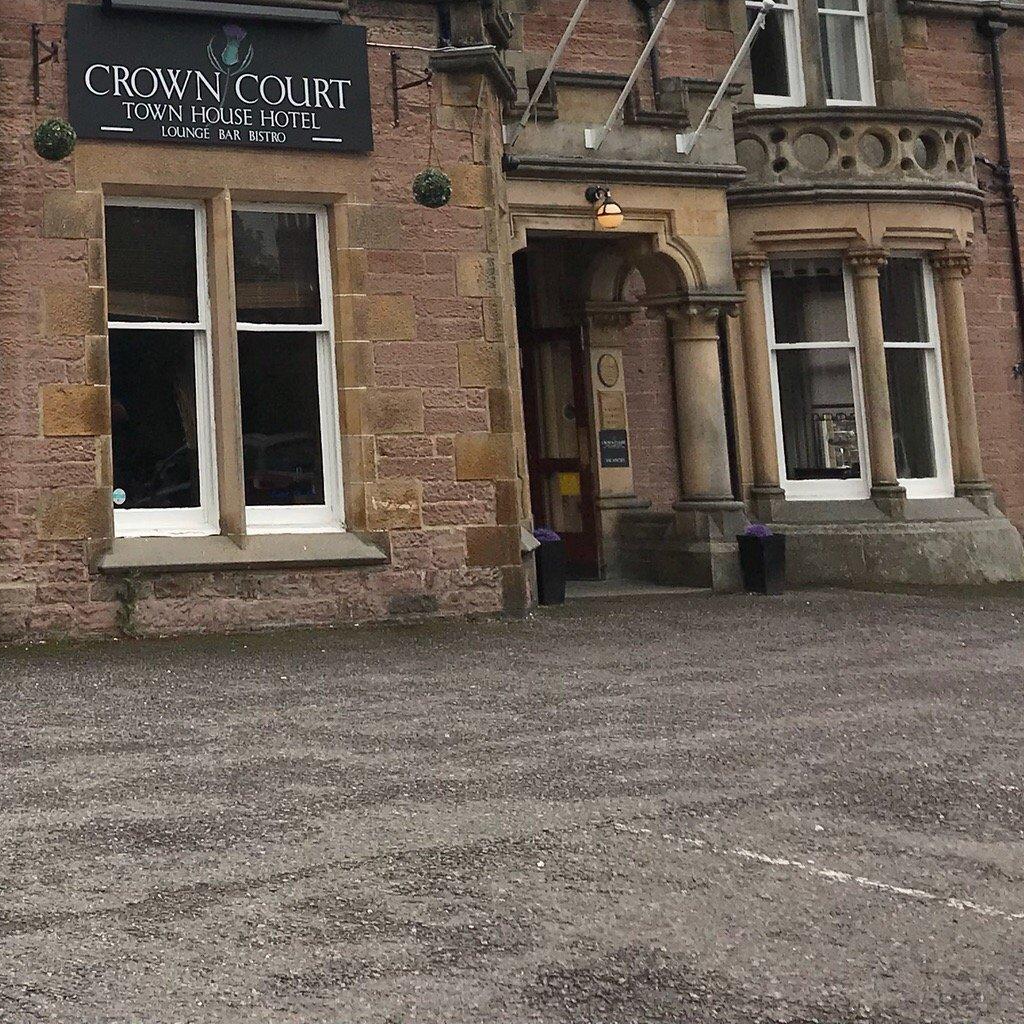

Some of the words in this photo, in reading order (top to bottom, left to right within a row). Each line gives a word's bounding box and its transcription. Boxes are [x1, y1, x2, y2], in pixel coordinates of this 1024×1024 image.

[84, 64, 222, 101] CROWN
[234, 73, 351, 109] COURT
[122, 102, 183, 123] TOWN
[191, 106, 253, 127] HOUSE
[260, 110, 321, 130] HOTEL
[161, 126, 211, 140] LOUNGE
[218, 129, 243, 142] BAR
[248, 130, 287, 144] BISTRO
